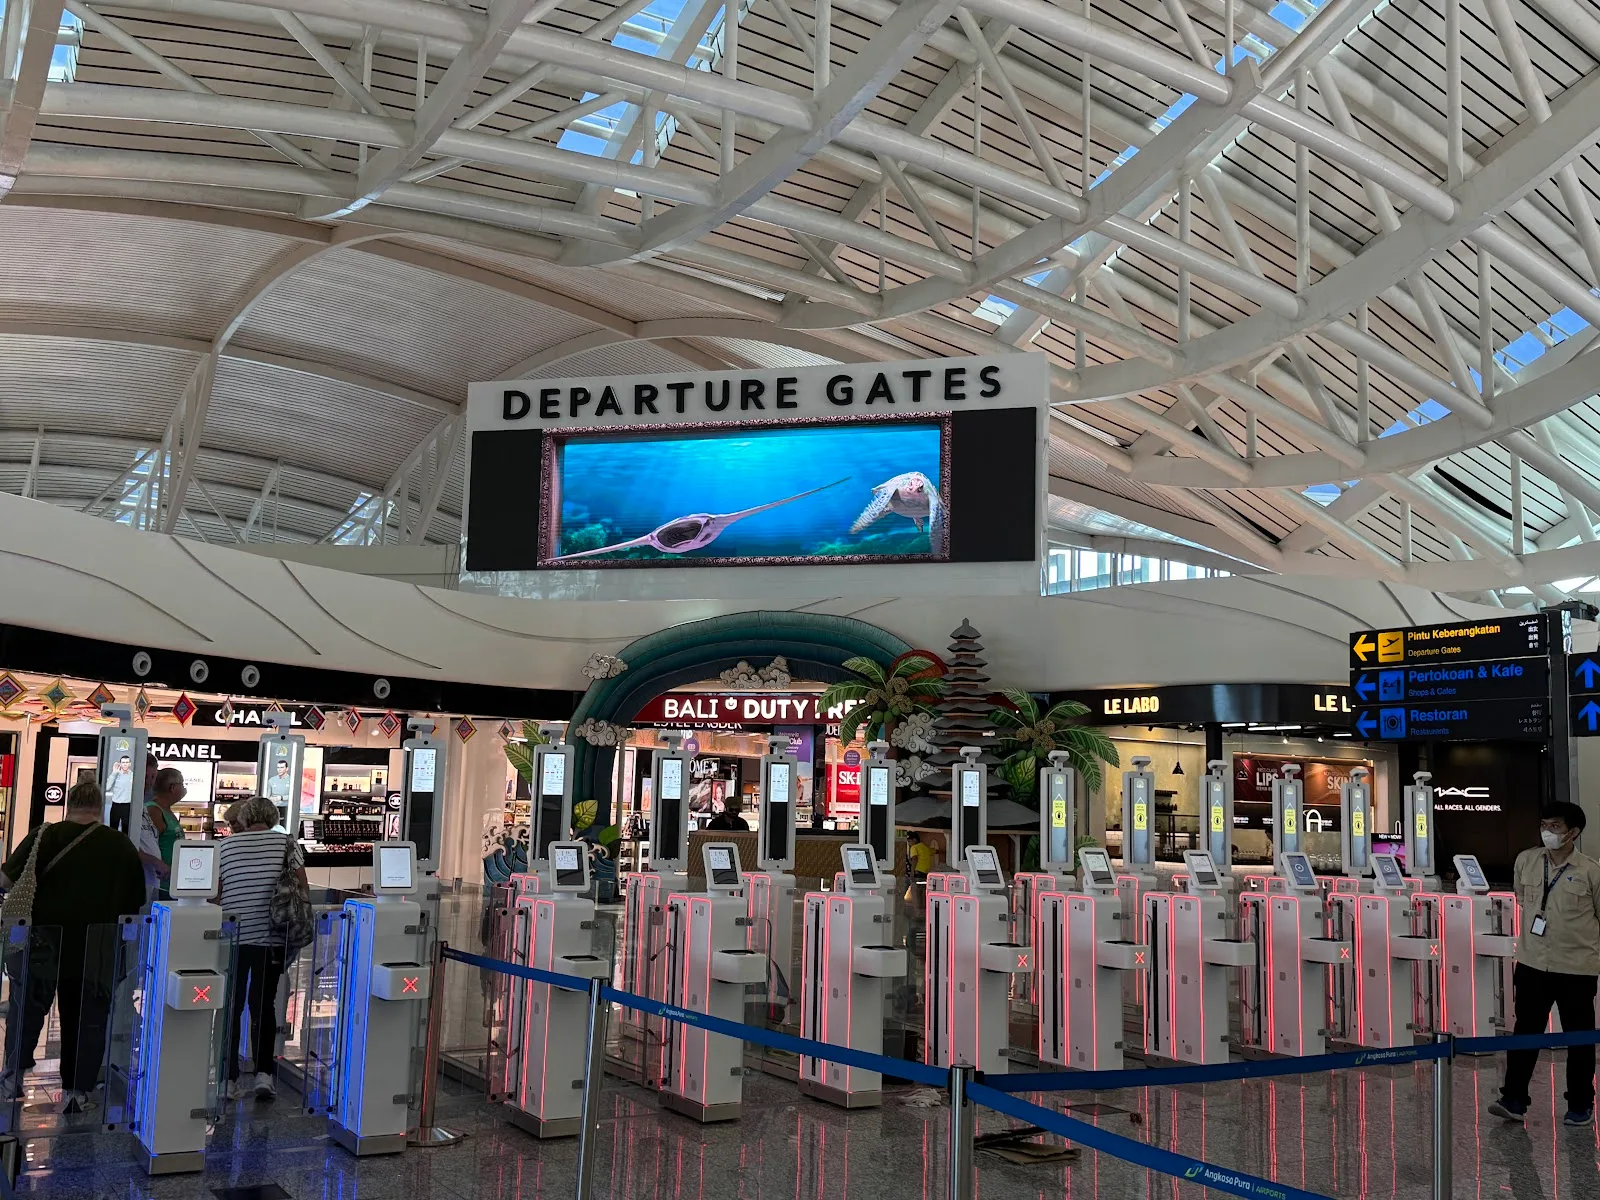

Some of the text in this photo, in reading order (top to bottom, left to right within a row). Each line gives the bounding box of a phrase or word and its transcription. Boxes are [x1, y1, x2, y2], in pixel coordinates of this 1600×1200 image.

[503, 366, 1001, 420] DEPARTURE GATES
[1407, 625, 1501, 641] Pintu Keberangkatan
[1408, 645, 1462, 658] Departure Gates
[1409, 664, 1524, 683] Pertokoan & Kafe
[1408, 689, 1429, 697] Shops
[664, 699, 719, 718] BALI
[744, 699, 809, 719] DUTY
[1104, 696, 1160, 715] LE LABO
[1314, 694, 1338, 711] LE
[1410, 709, 1468, 722] Restoran
[1410, 727, 1451, 736] Restaurants
[1475, 804, 1502, 812] GENDERS.
[1204, 1168, 1287, 1200] Angkasa Pura AIRPORTS
